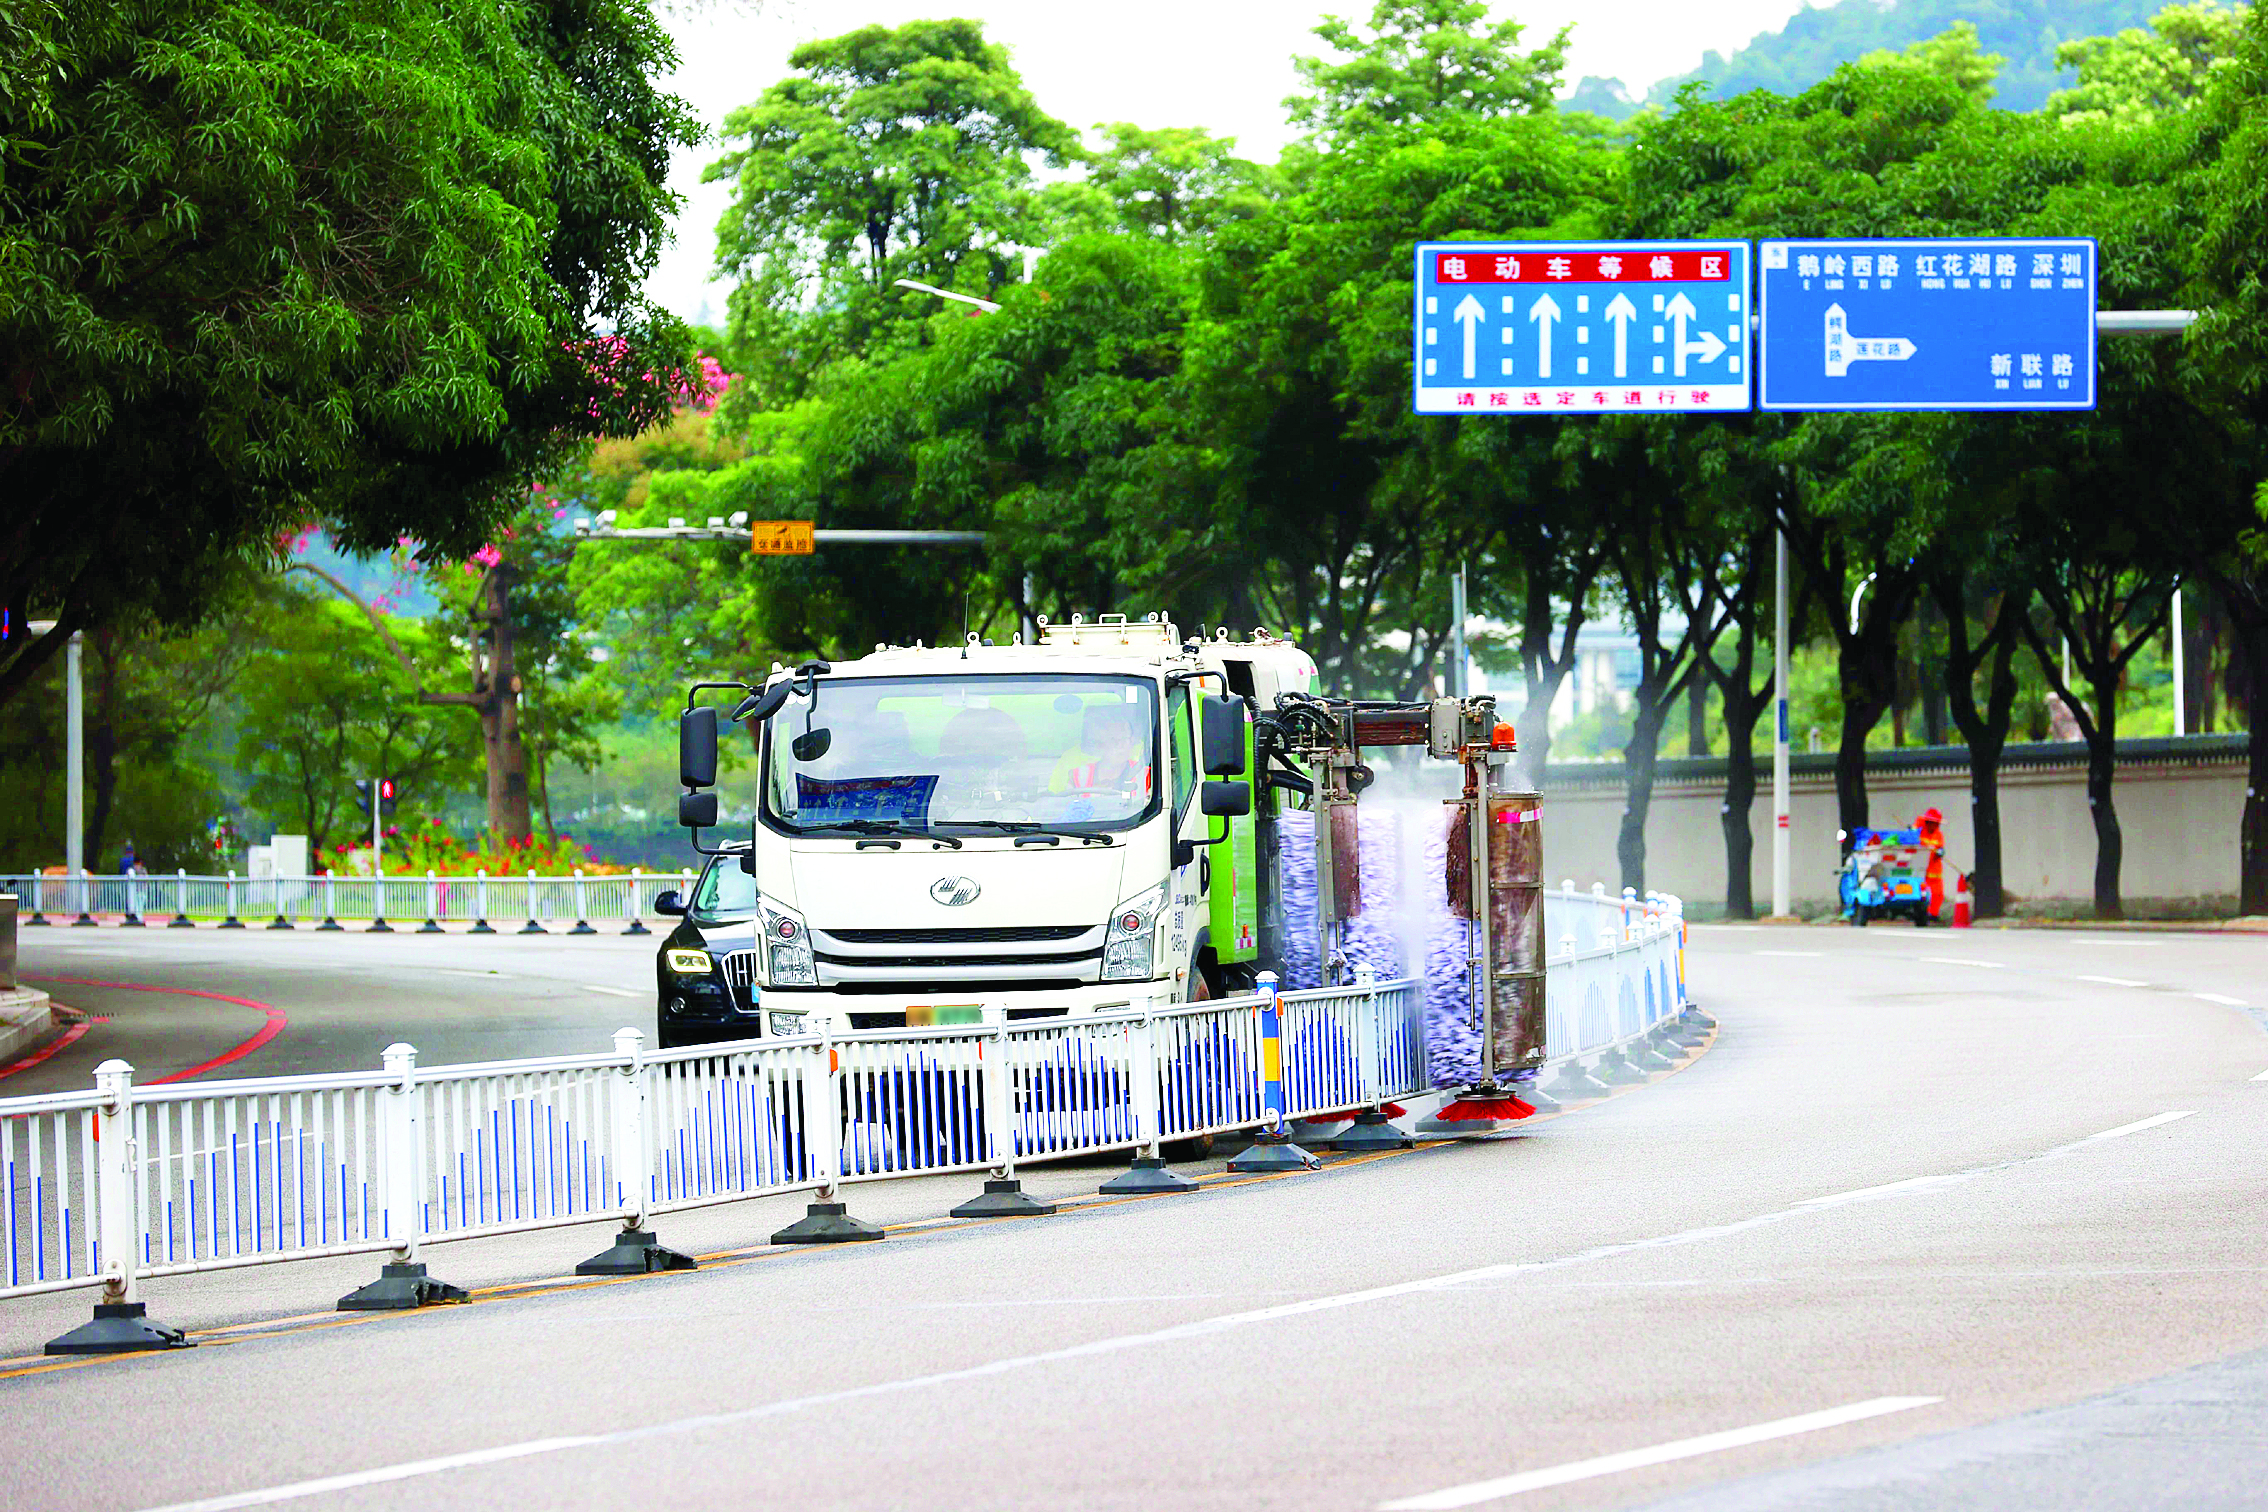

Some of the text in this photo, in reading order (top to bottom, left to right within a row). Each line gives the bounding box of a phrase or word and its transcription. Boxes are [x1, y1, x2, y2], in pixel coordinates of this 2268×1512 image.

[1443, 256, 1722, 280] 电动车等候区
[1797, 253, 2082, 277] 鹅岭西路 红花湖路 深圳
[1990, 353, 2074, 376] 新联路
[1457, 390, 1710, 407] 请按选定车道行驶
